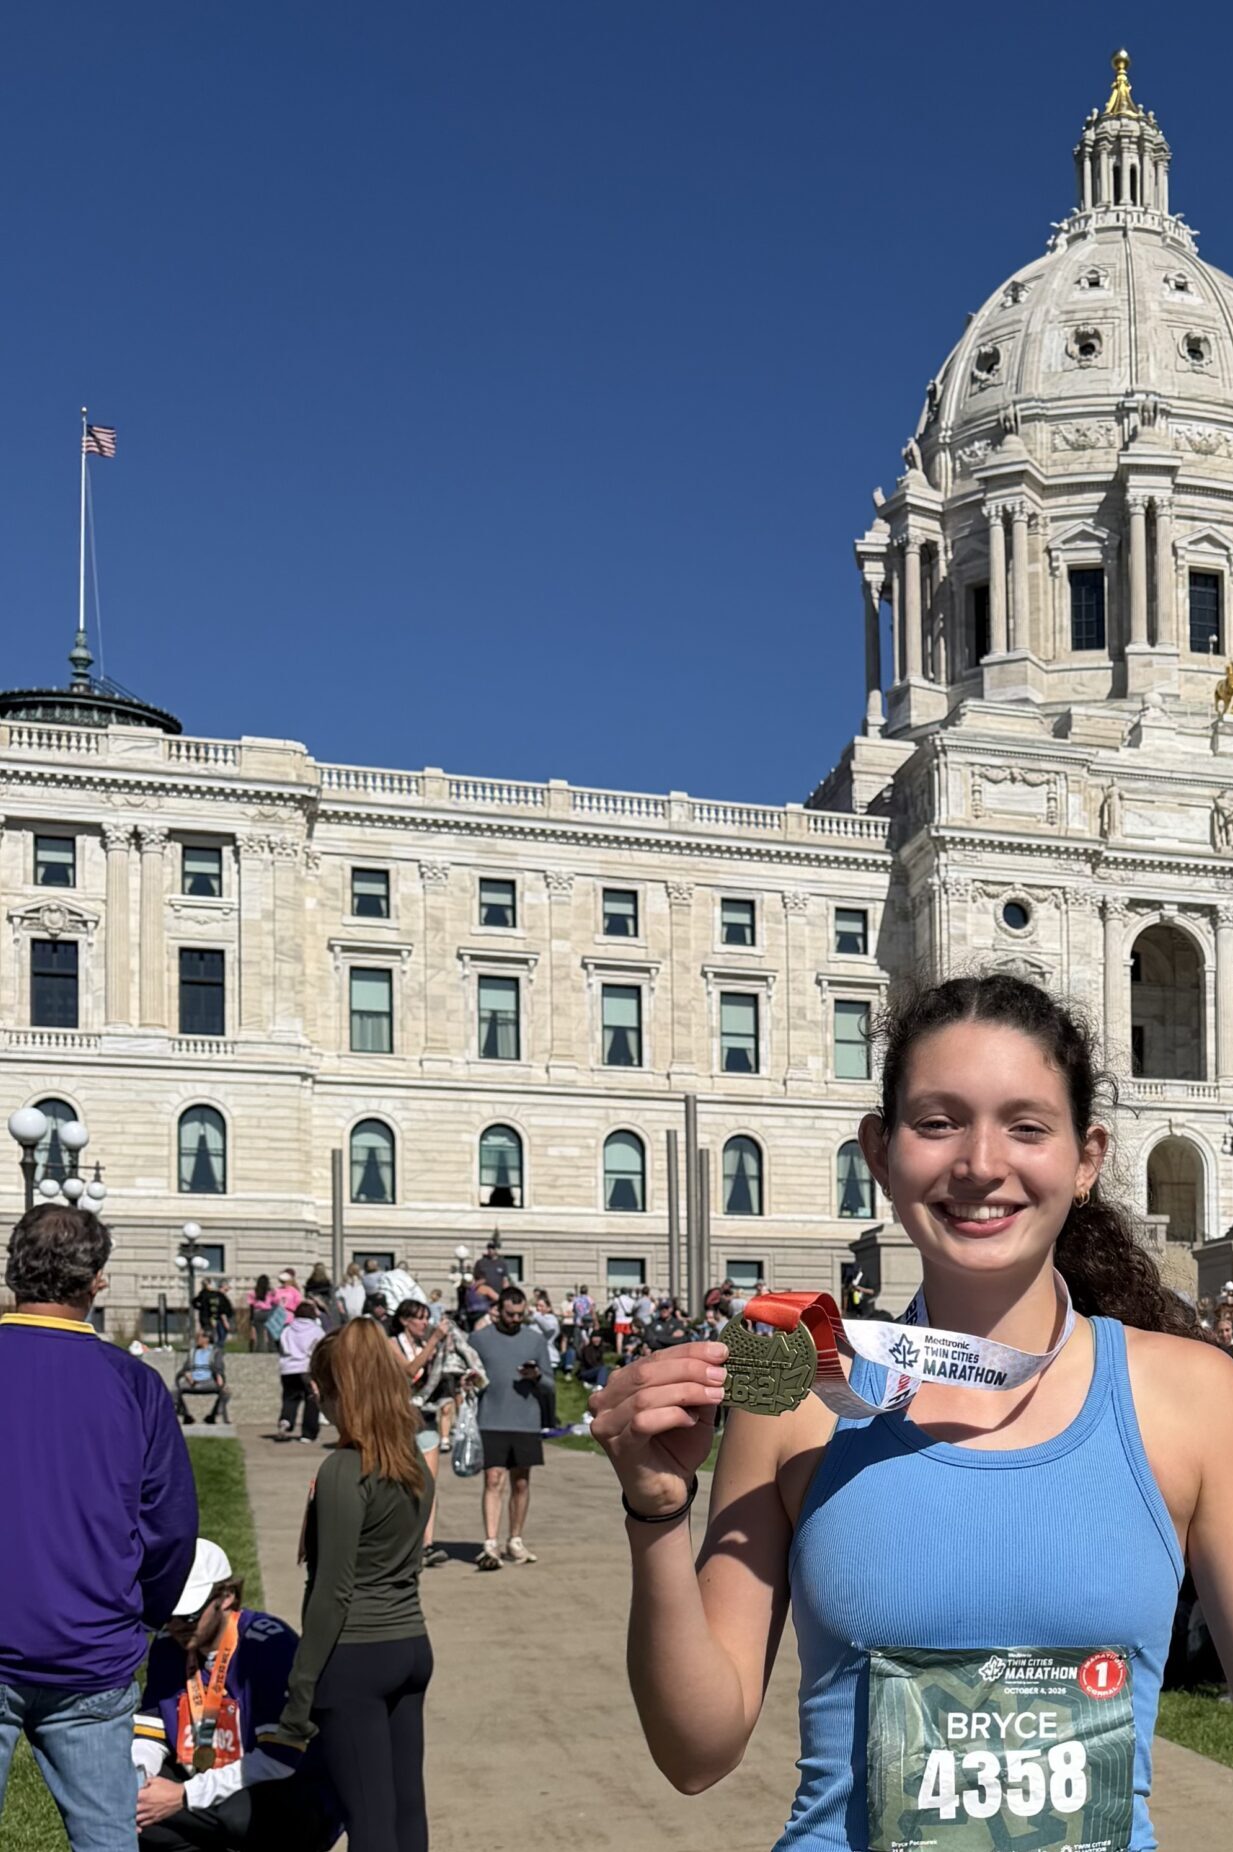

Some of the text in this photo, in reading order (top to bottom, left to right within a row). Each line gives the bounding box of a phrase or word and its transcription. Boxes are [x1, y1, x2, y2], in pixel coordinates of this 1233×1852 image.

[924, 1335, 970, 1350] Medtronic
[924, 1346, 979, 1364] TWIN CITIES
[922, 1358, 1008, 1386] MARATHON
[245, 1619, 284, 1641] 19
[1005, 1667, 1078, 1680] MARATHON
[1095, 1661, 1109, 1688] 1
[947, 1712, 1057, 1739] BRYCE
[917, 1740, 1088, 1820] 4358
